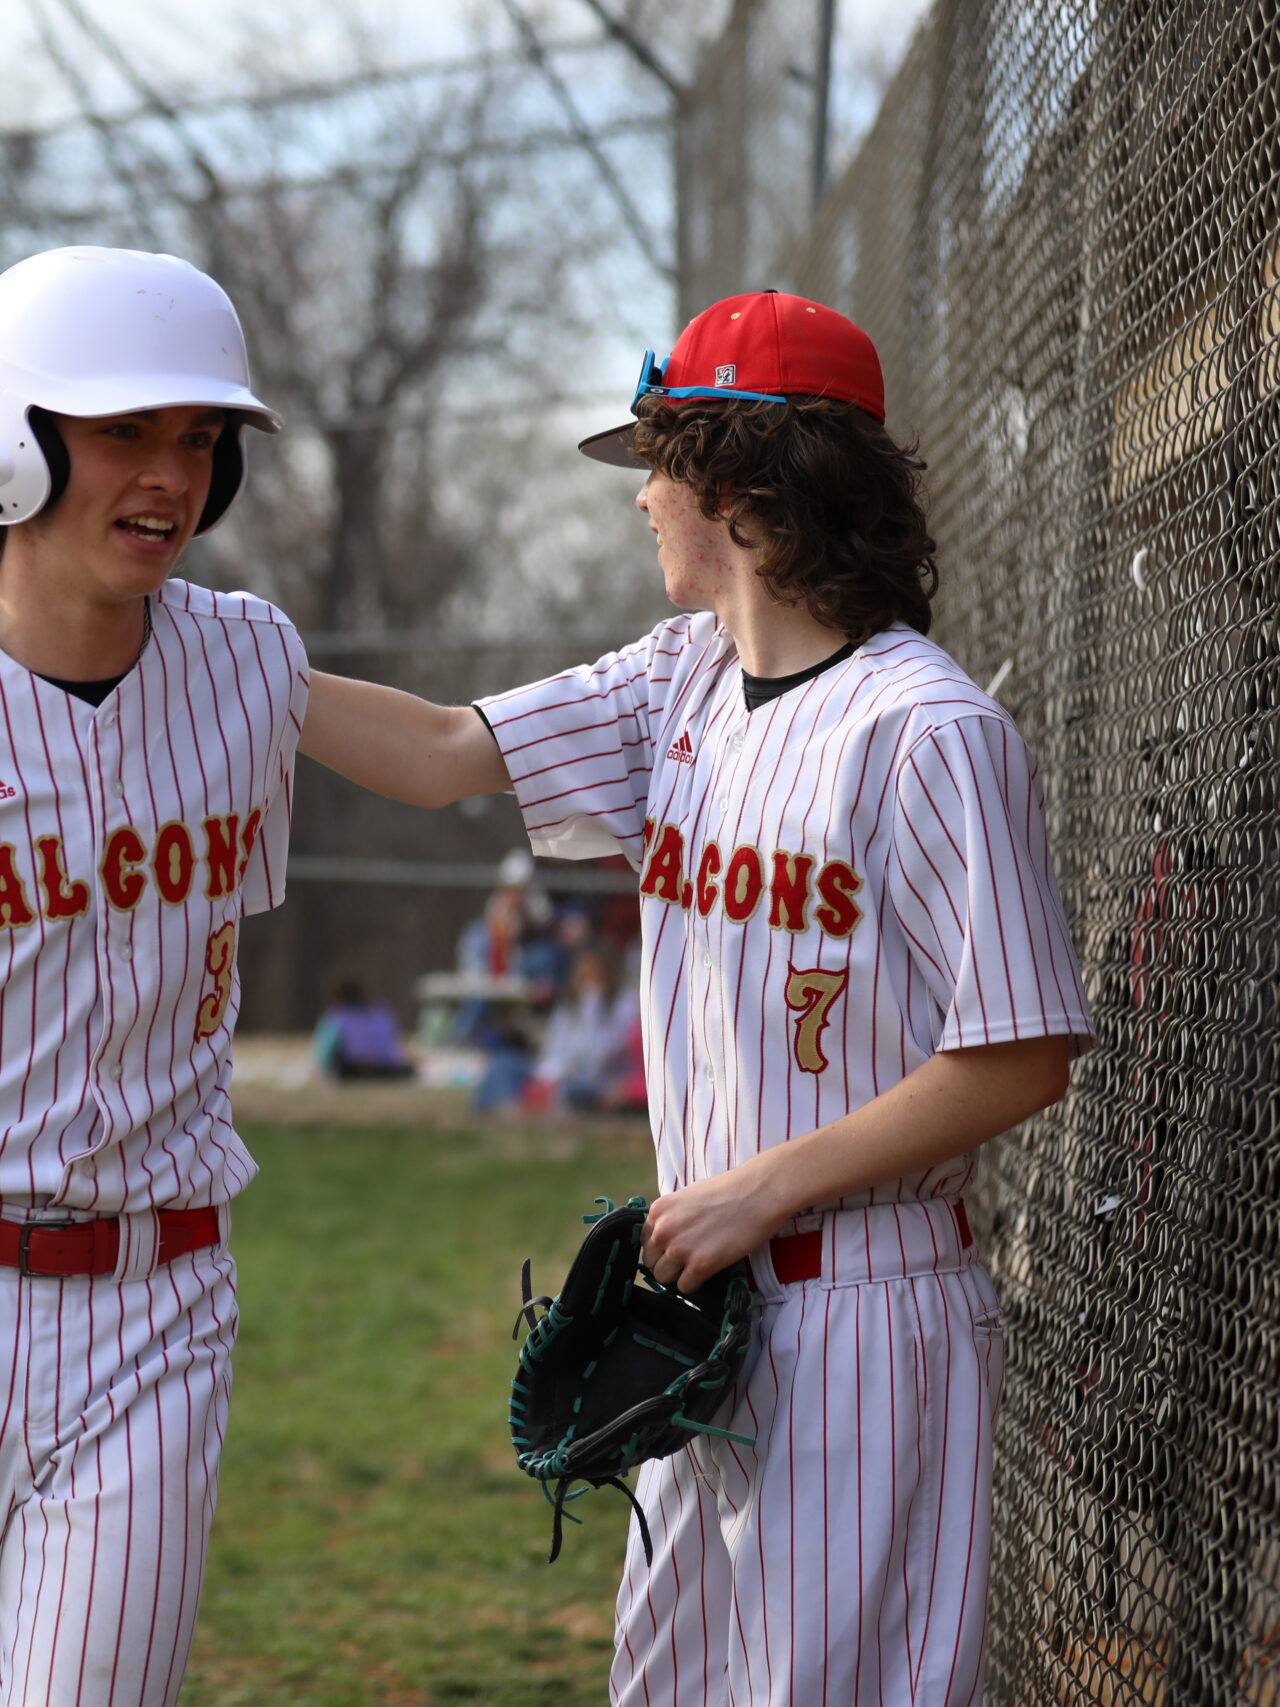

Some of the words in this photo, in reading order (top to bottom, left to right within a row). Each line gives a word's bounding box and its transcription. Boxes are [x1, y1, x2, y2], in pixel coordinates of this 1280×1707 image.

[640, 815, 865, 939] ACONS
[194, 920, 235, 1044] 3
[784, 961, 850, 1074] 7
